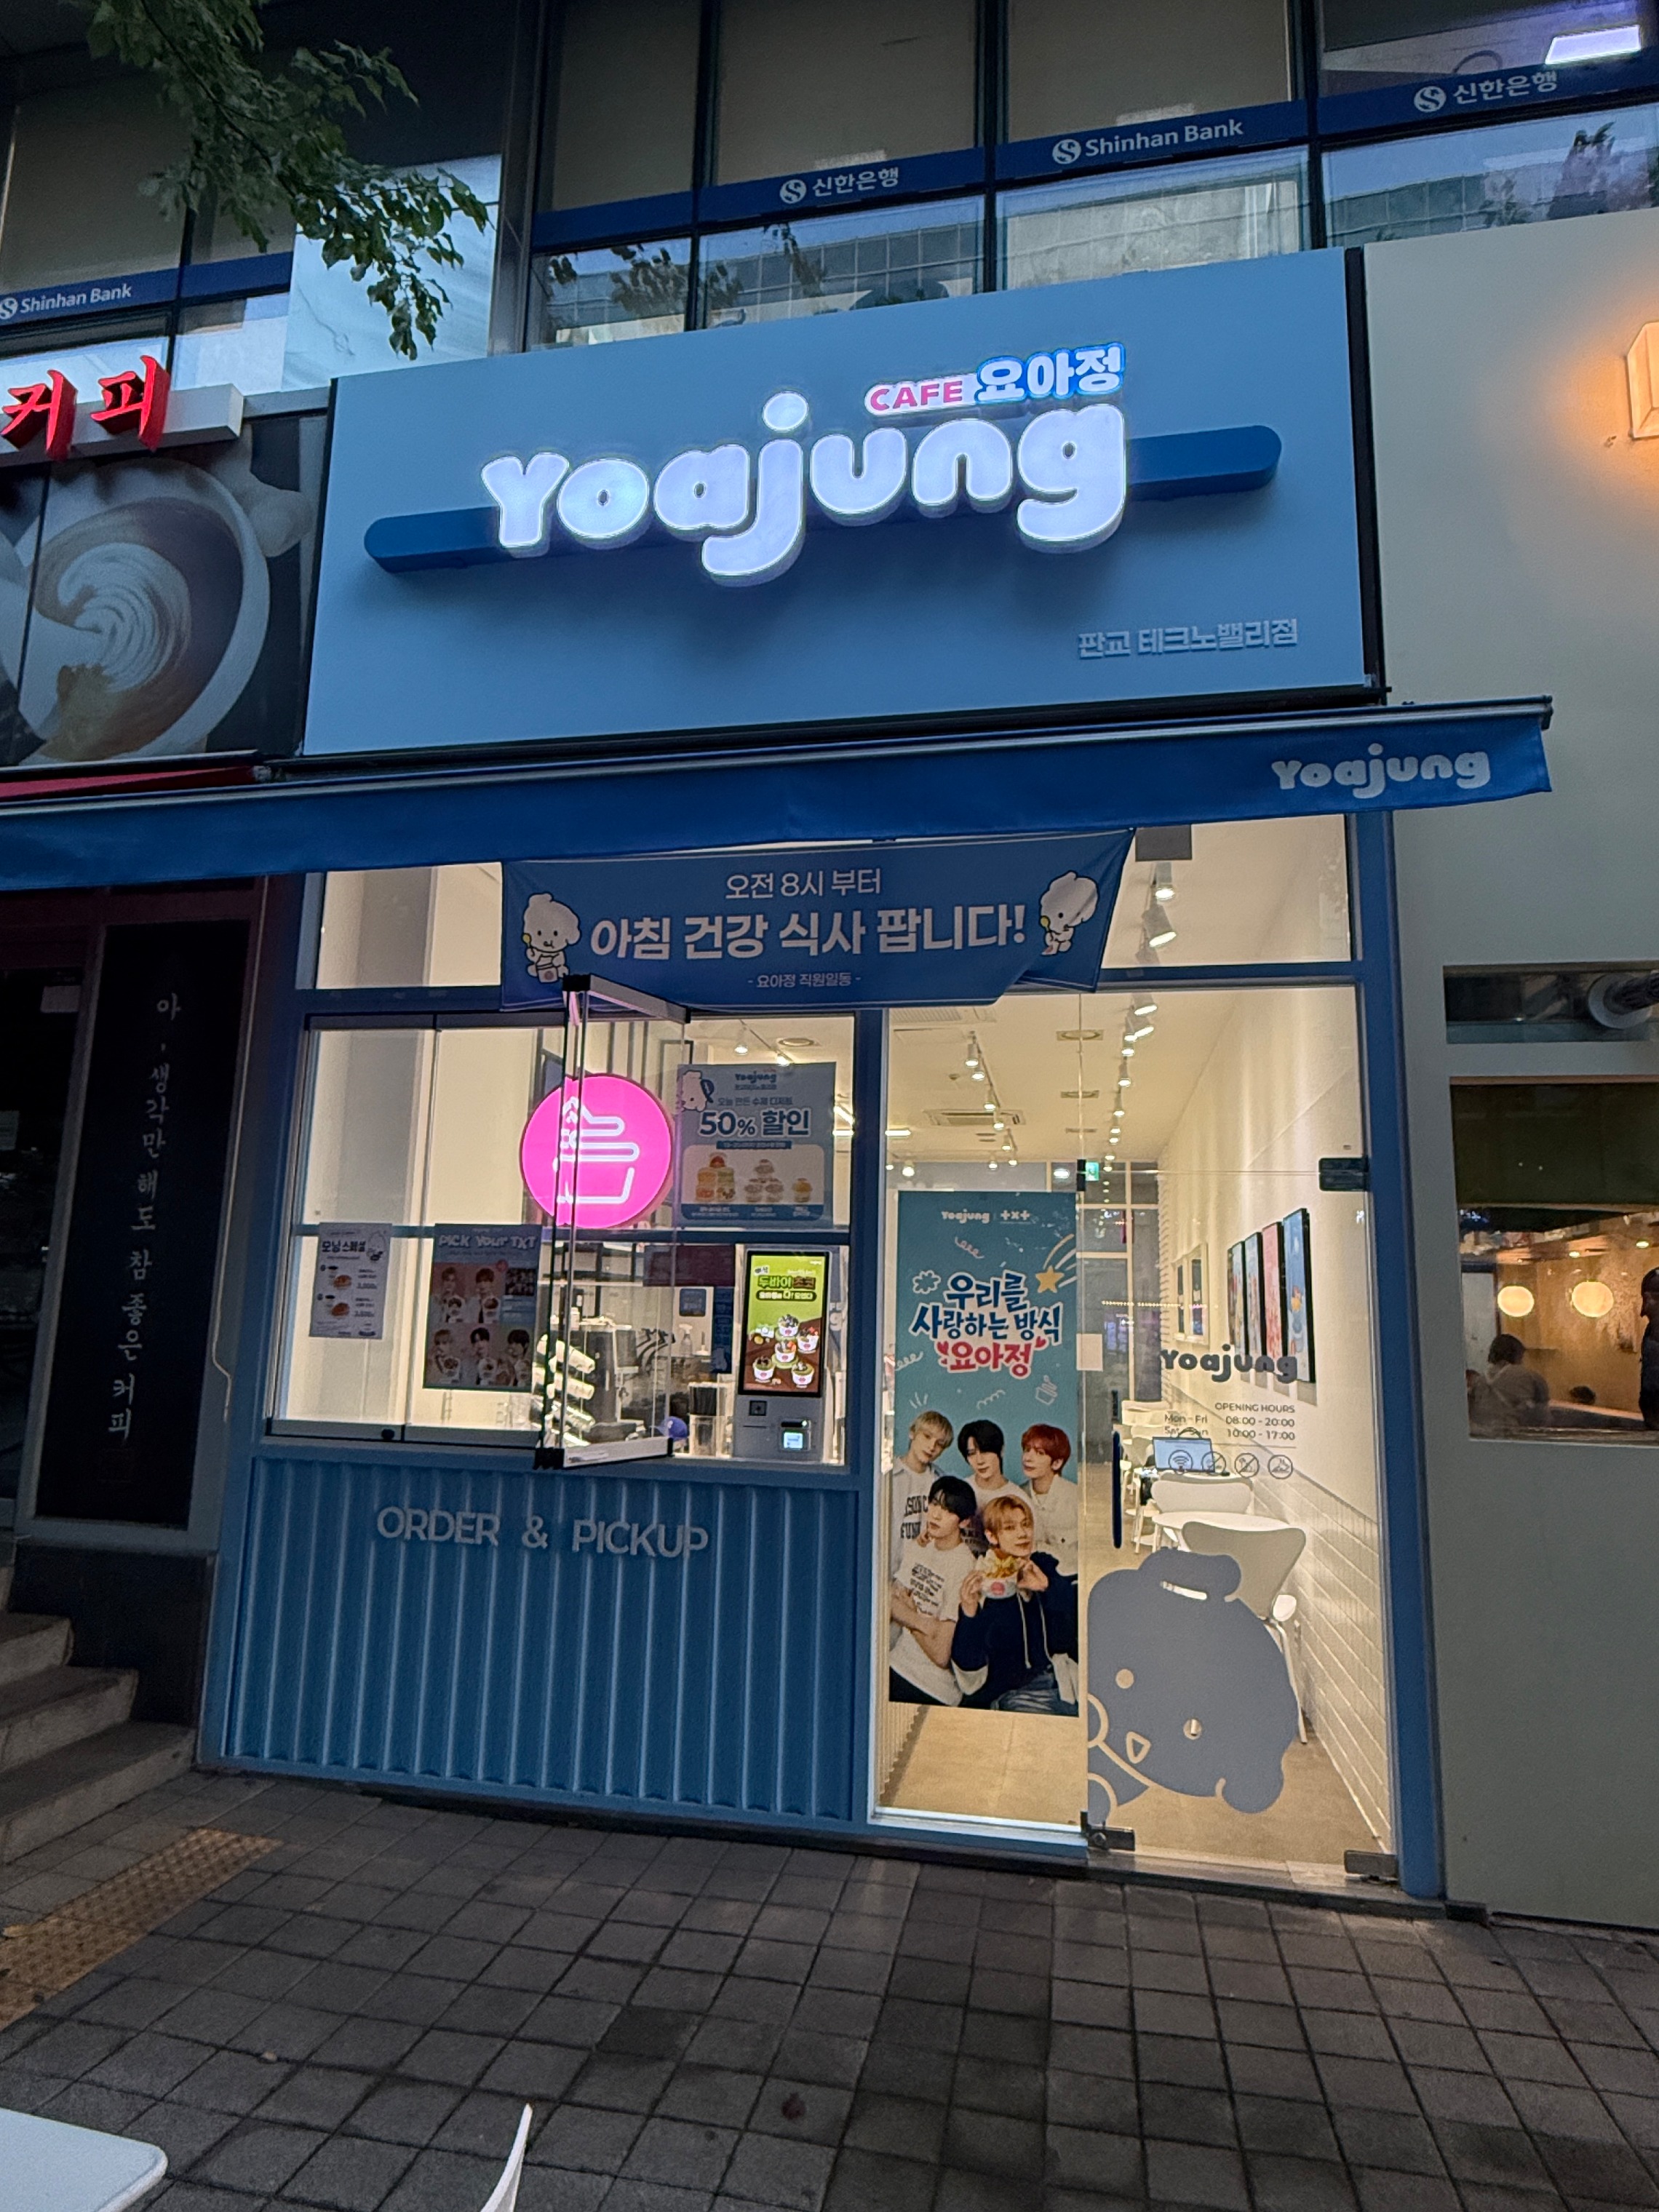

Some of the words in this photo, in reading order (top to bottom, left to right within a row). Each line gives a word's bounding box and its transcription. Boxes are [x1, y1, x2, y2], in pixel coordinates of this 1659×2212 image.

[1453, 70, 1557, 104] 신한은행
[1085, 131, 1178, 156] Shinhan
[1184, 119, 1244, 143] Bank
[812, 167, 899, 197] 신한은행
[20, 293, 87, 314] Shinhan
[90, 283, 132, 303] Bank
[869, 381, 963, 412] CAFE
[976, 344, 1124, 403] 요아정
[1, 356, 169, 460] 커피
[481, 391, 1126, 581] Yoajung
[1078, 632, 1130, 659] 판교
[1137, 618, 1298, 655] 테크노밸리점
[1271, 742, 1491, 799] Yoajung
[725, 873, 774, 899] 오전
[780, 870, 824, 896] 8시
[831, 868, 882, 896] 부터
[590, 917, 671, 959] 아침
[684, 915, 768, 958] 건강
[779, 910, 866, 955] 식사
[876, 904, 1026, 953] 팝니다!
[756, 974, 796, 988] 요아정
[799, 972, 852, 987] 직원일동
[143, 1063, 170, 1159] 생각만
[699, 1110, 757, 1137] 50%
[761, 1108, 810, 1137] 할인
[130, 1169, 159, 1232] 해도
[941, 1208, 990, 1224] Yoajung
[437, 1234, 470, 1247] PICK
[510, 1236, 537, 1249] TXT
[129, 1249, 153, 1282] 참
[757, 1276, 792, 1289] 두바이
[944, 1270, 1029, 1314] 우리를
[911, 1305, 1009, 1341] 사랑하는
[1014, 1305, 1062, 1344] 방식
[948, 1341, 1033, 1378] 요아정
[1161, 1344, 1298, 1384] Yoajung
[108, 1373, 135, 1441] 커피
[1164, 1414, 1186, 1423] Mon
[1195, 1415, 1208, 1424] Fri
[1225, 1415, 1256, 1425] 08:00
[1265, 1417, 1295, 1427] 20:00
[1214, 1402, 1259, 1412] OPENING
[1261, 1404, 1295, 1413] HOURS
[1227, 1428, 1256, 1439] 10:00
[1266, 1430, 1295, 1440] 17:00
[377, 1506, 501, 1546] ORDER
[521, 1514, 549, 1549] &
[571, 1519, 709, 1559] PICKUP
